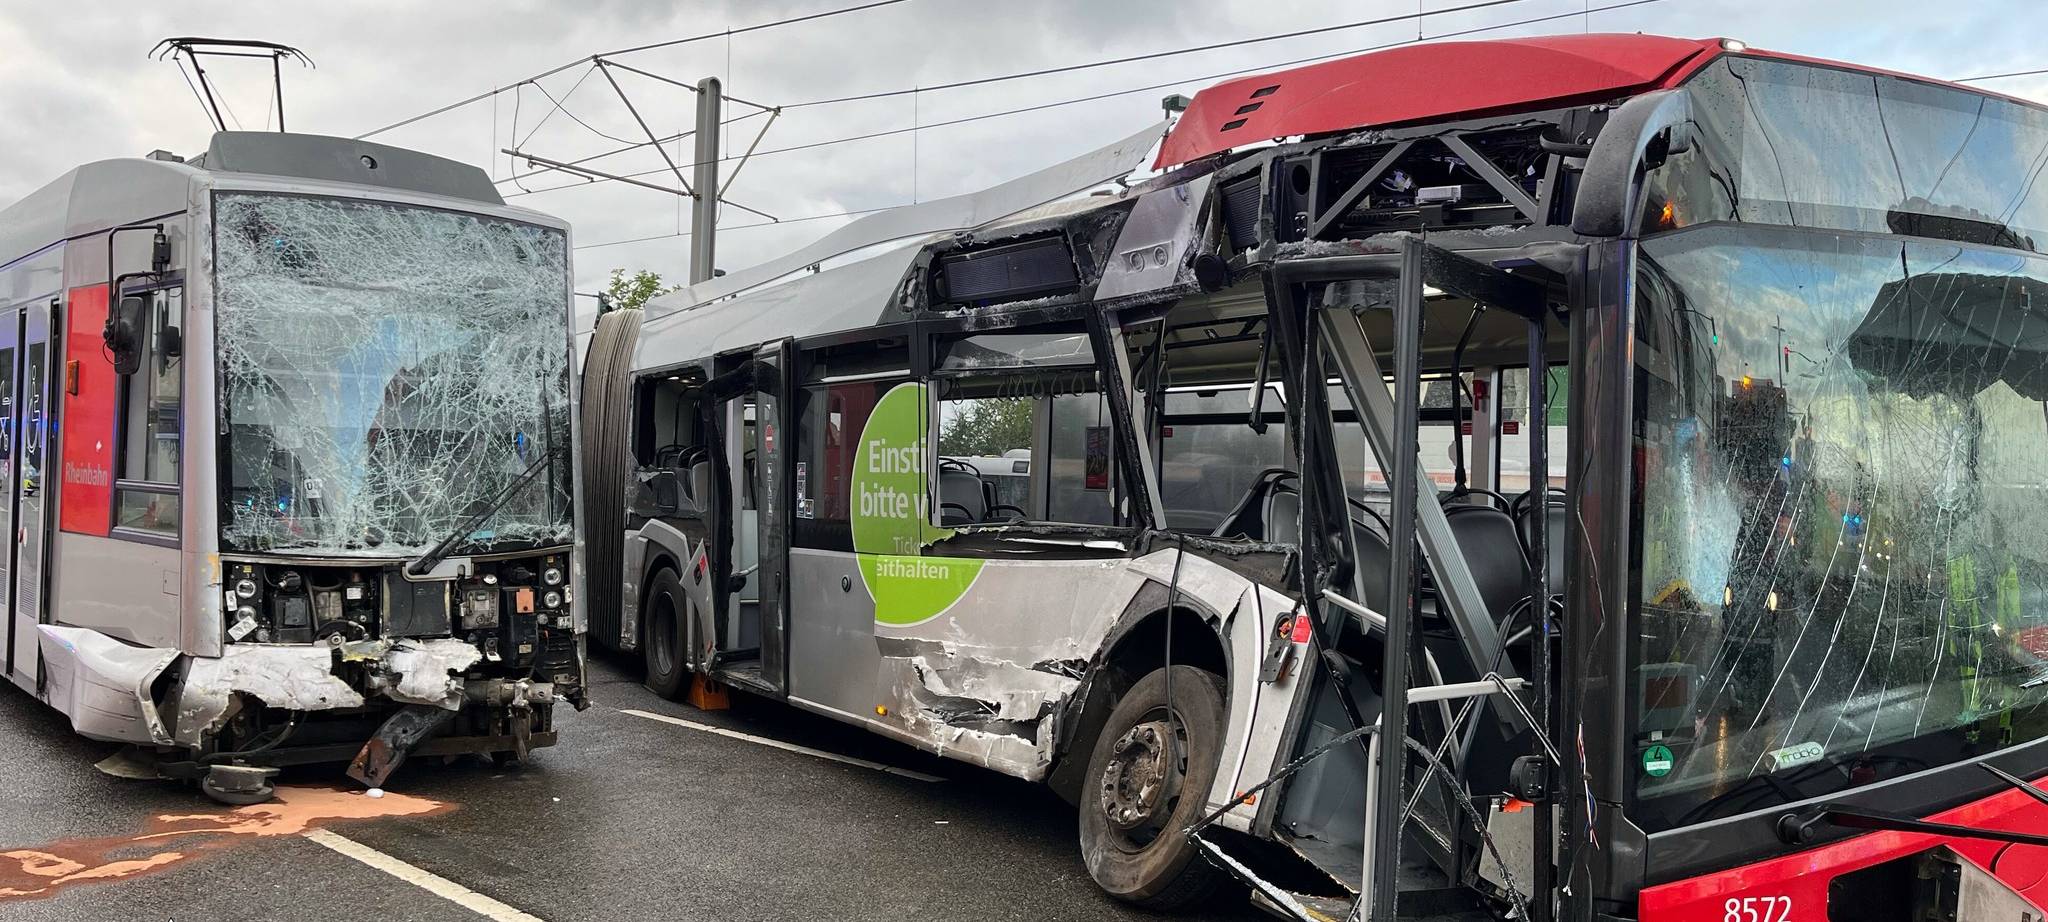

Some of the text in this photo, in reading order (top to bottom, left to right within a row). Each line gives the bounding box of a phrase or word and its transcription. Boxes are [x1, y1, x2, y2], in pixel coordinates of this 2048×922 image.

[868, 438, 927, 474] Einsti
[64, 461, 108, 487] Rheinbahn
[859, 481, 909, 518] bitte
[1653, 746, 1664, 761] 4
[1723, 895, 1792, 922] 8572
